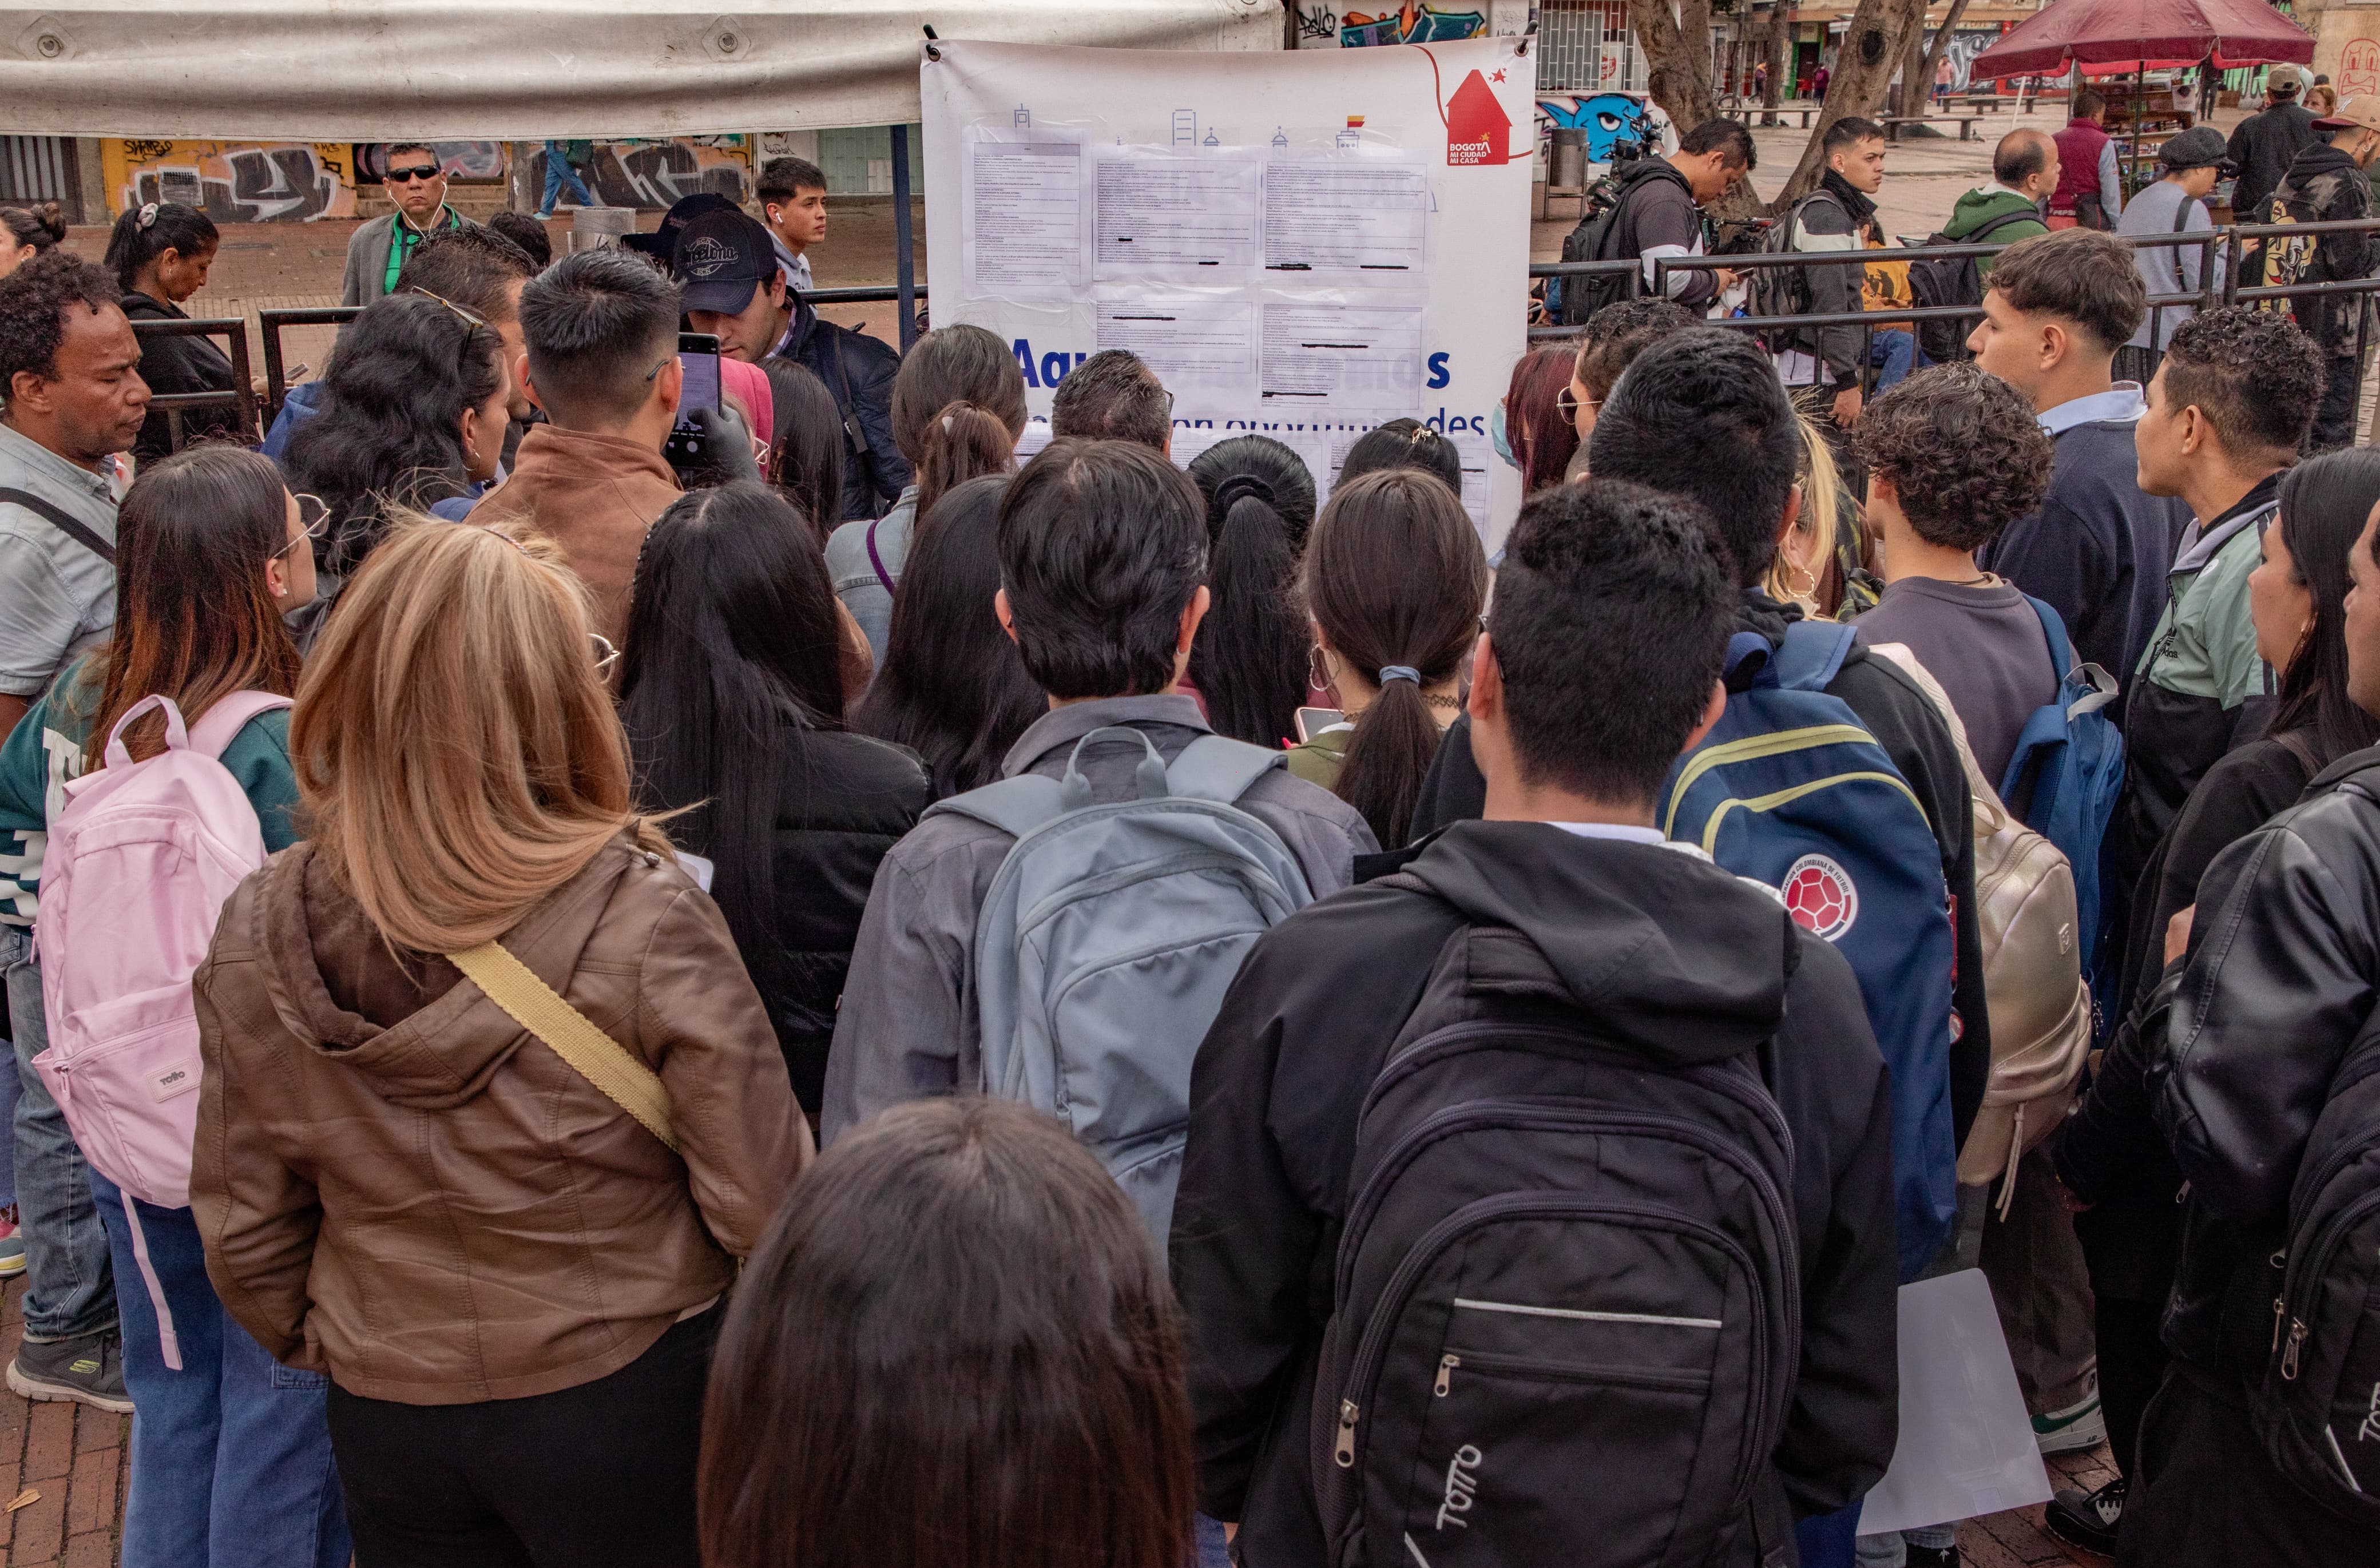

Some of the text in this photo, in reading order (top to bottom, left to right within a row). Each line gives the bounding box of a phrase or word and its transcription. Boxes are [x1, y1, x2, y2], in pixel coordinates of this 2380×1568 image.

[1796, 859, 1827, 872] COLOMBIANA
[1827, 866, 1834, 874] DE
[1834, 872, 1850, 894] FUTBOL
[1436, 1444, 1482, 1530] TOTTO
